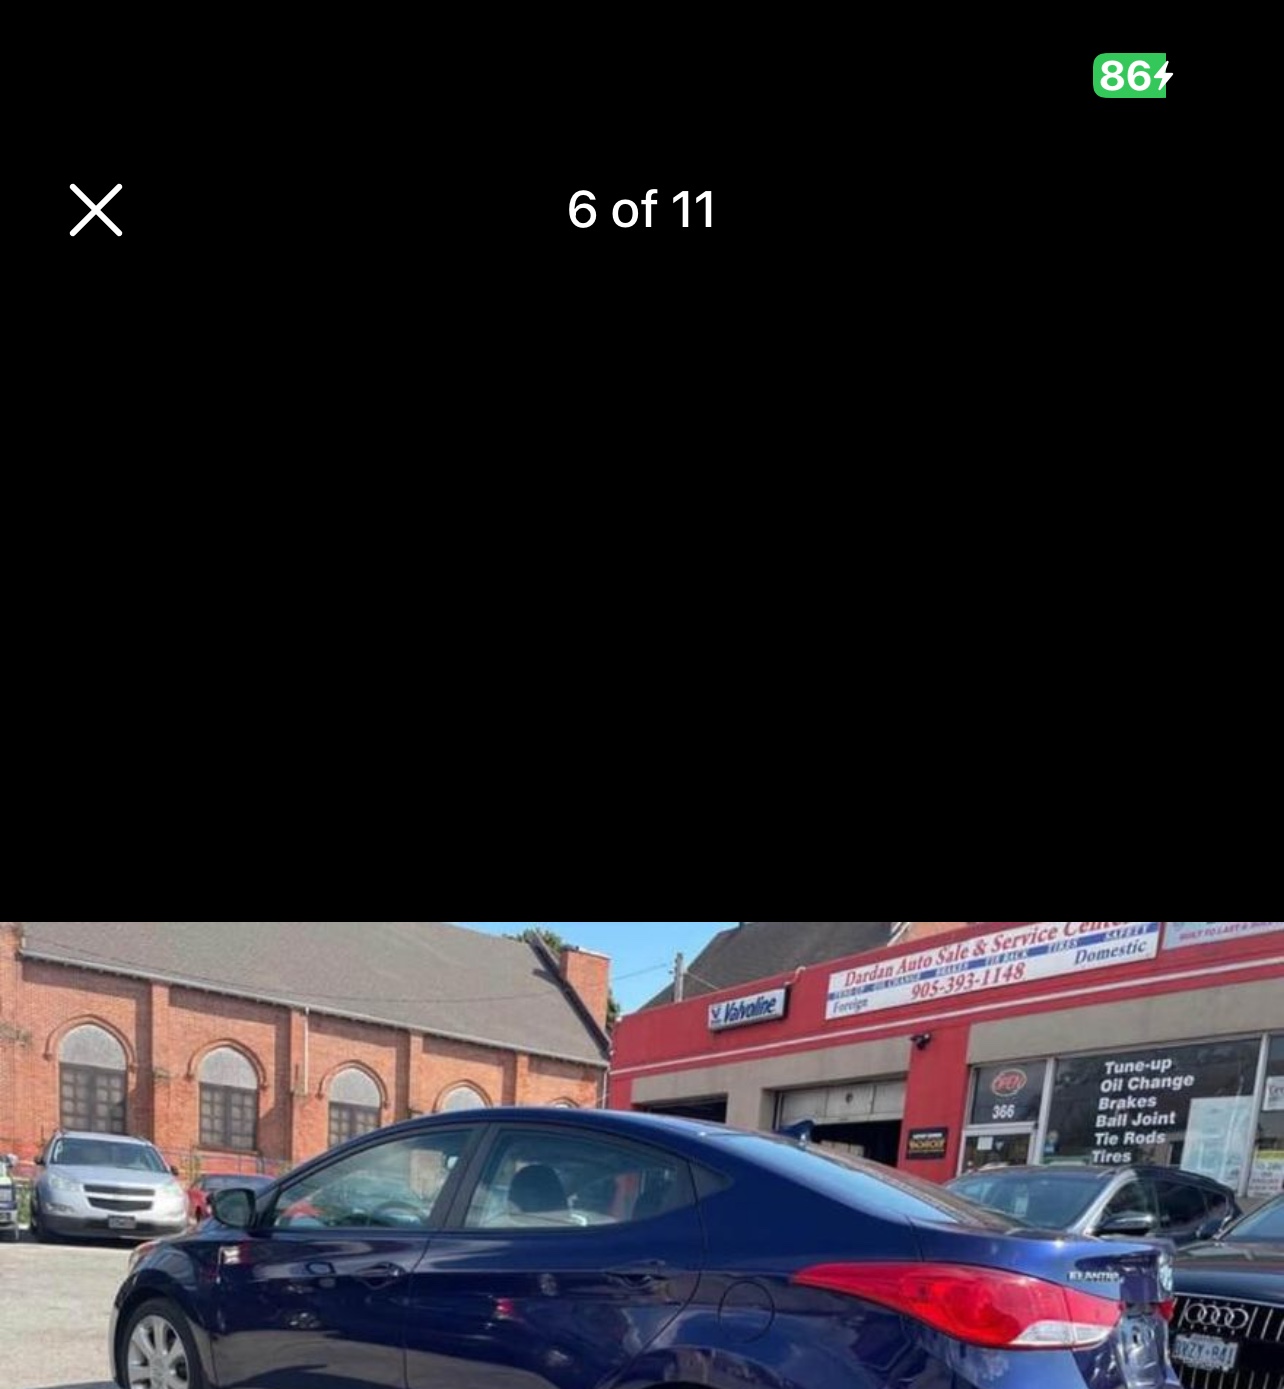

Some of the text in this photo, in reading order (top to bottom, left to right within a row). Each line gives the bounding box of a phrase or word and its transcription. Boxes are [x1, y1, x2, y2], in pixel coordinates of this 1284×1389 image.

[844, 964, 894, 987] Dardan
[897, 956, 933, 974] Auto
[936, 943, 970, 965] Sale
[972, 939, 987, 958] &
[991, 926, 1058, 952] Service
[1075, 939, 1147, 965] Domestic
[911, 962, 1026, 999] 905-393-1148
[724, 995, 777, 1023] Valvoline
[833, 998, 868, 1014] Foreign
[1104, 1058, 1172, 1075] Tune-up
[1100, 1075, 1195, 1093] Oil Change
[1098, 1095, 1157, 1110] Brakes
[992, 1104, 1015, 1119] 366
[1095, 1111, 1176, 1128] Ball Joint
[1094, 1131, 1167, 1146] Tie Rods
[1091, 1149, 1132, 1164] Tires
